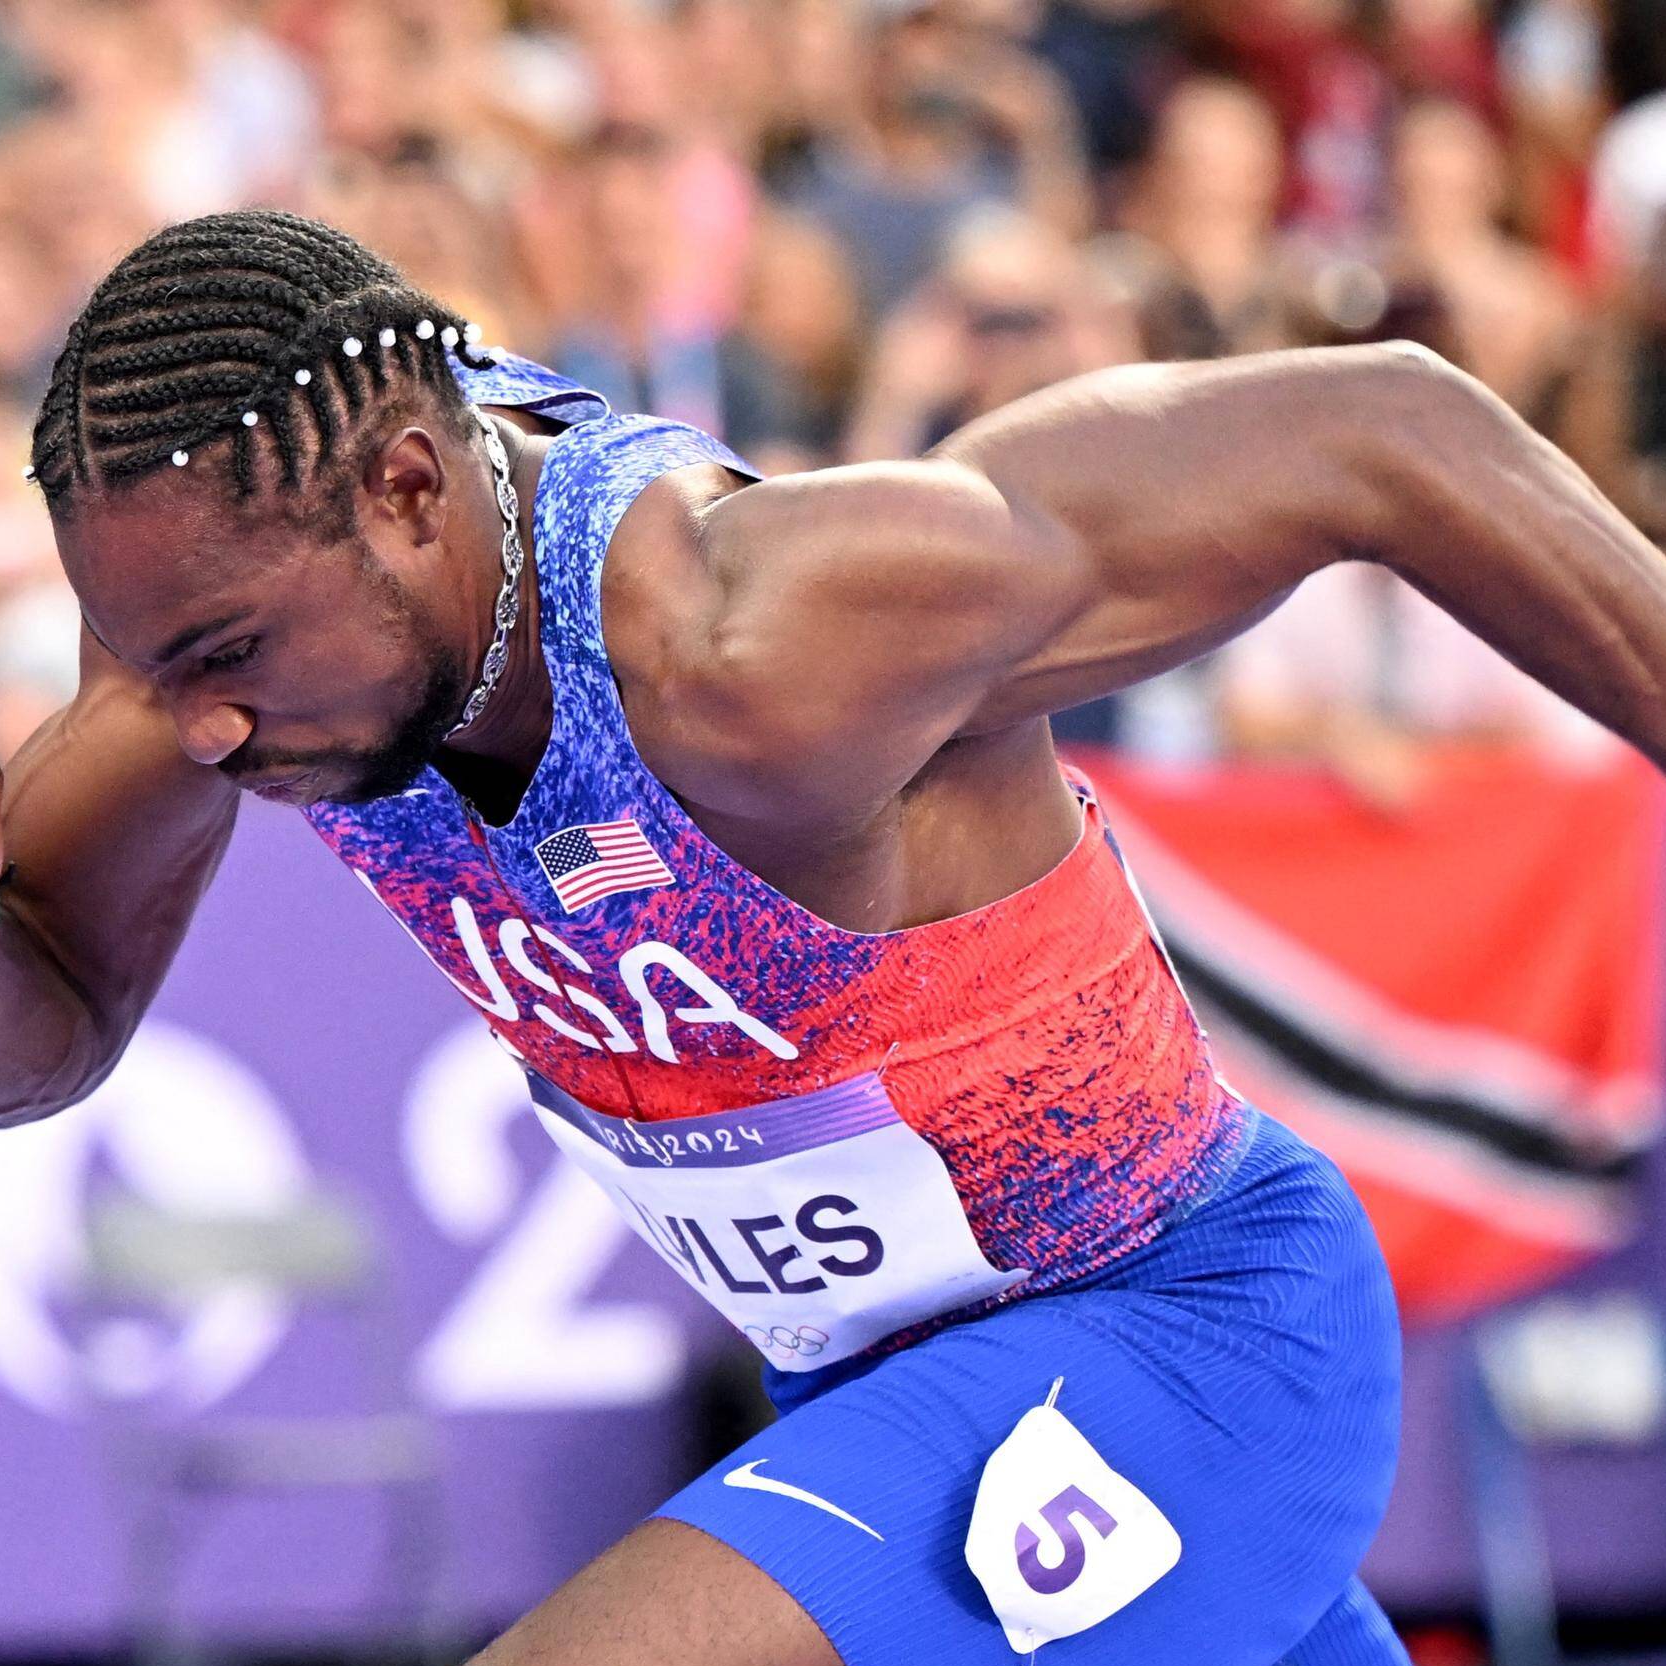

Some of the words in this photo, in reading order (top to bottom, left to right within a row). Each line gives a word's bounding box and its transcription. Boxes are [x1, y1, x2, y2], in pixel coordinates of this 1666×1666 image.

[353, 866, 800, 1064] USA
[662, 1125, 764, 1157] 2024
[1014, 1483, 1119, 1595] 5
